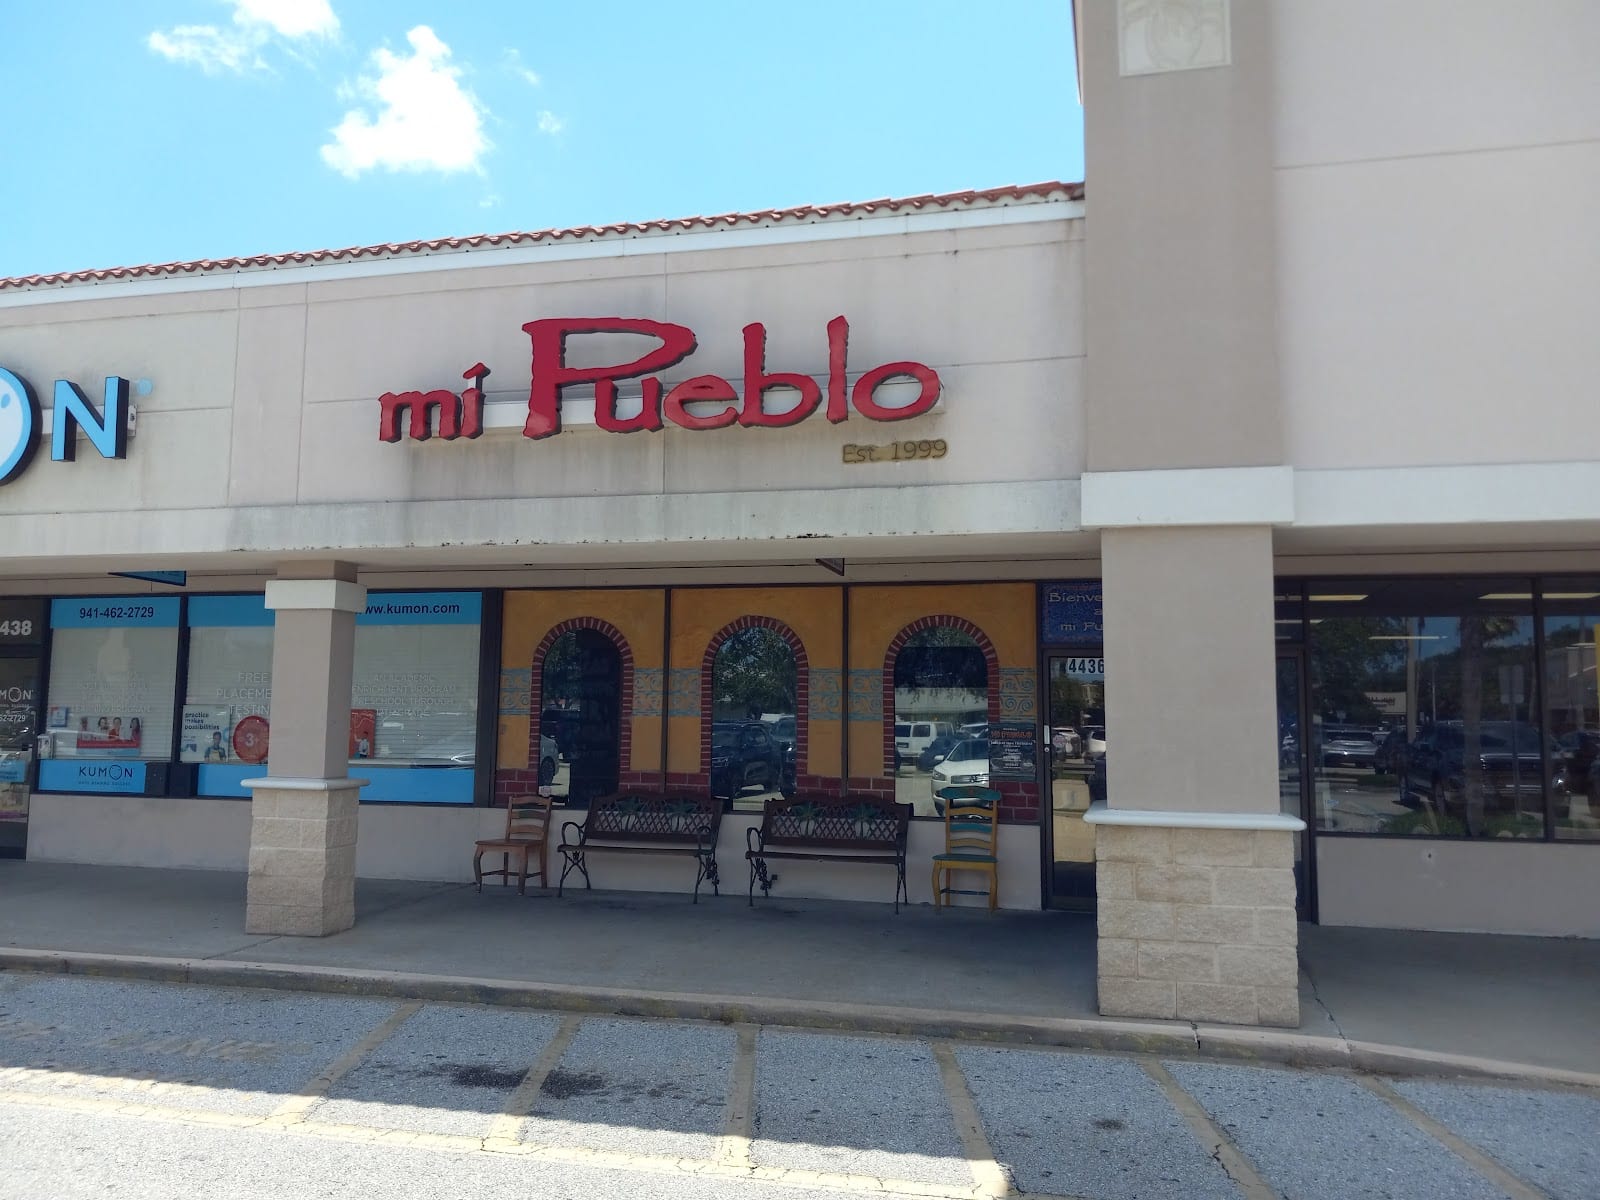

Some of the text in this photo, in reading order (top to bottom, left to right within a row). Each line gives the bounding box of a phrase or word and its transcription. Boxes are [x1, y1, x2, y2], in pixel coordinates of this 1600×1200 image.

[379, 315, 940, 443] mi Pueblo
[891, 439, 947, 460] 1999
[80, 607, 154, 619] 941-462-2729
[356, 603, 460, 615] ww.kumon.com
[1068, 658, 1104, 674] 4436
[239, 672, 270, 683] FREE
[184, 711, 209, 719] practice
[184, 723, 220, 731] possibilities
[78, 764, 133, 781] KUMON
